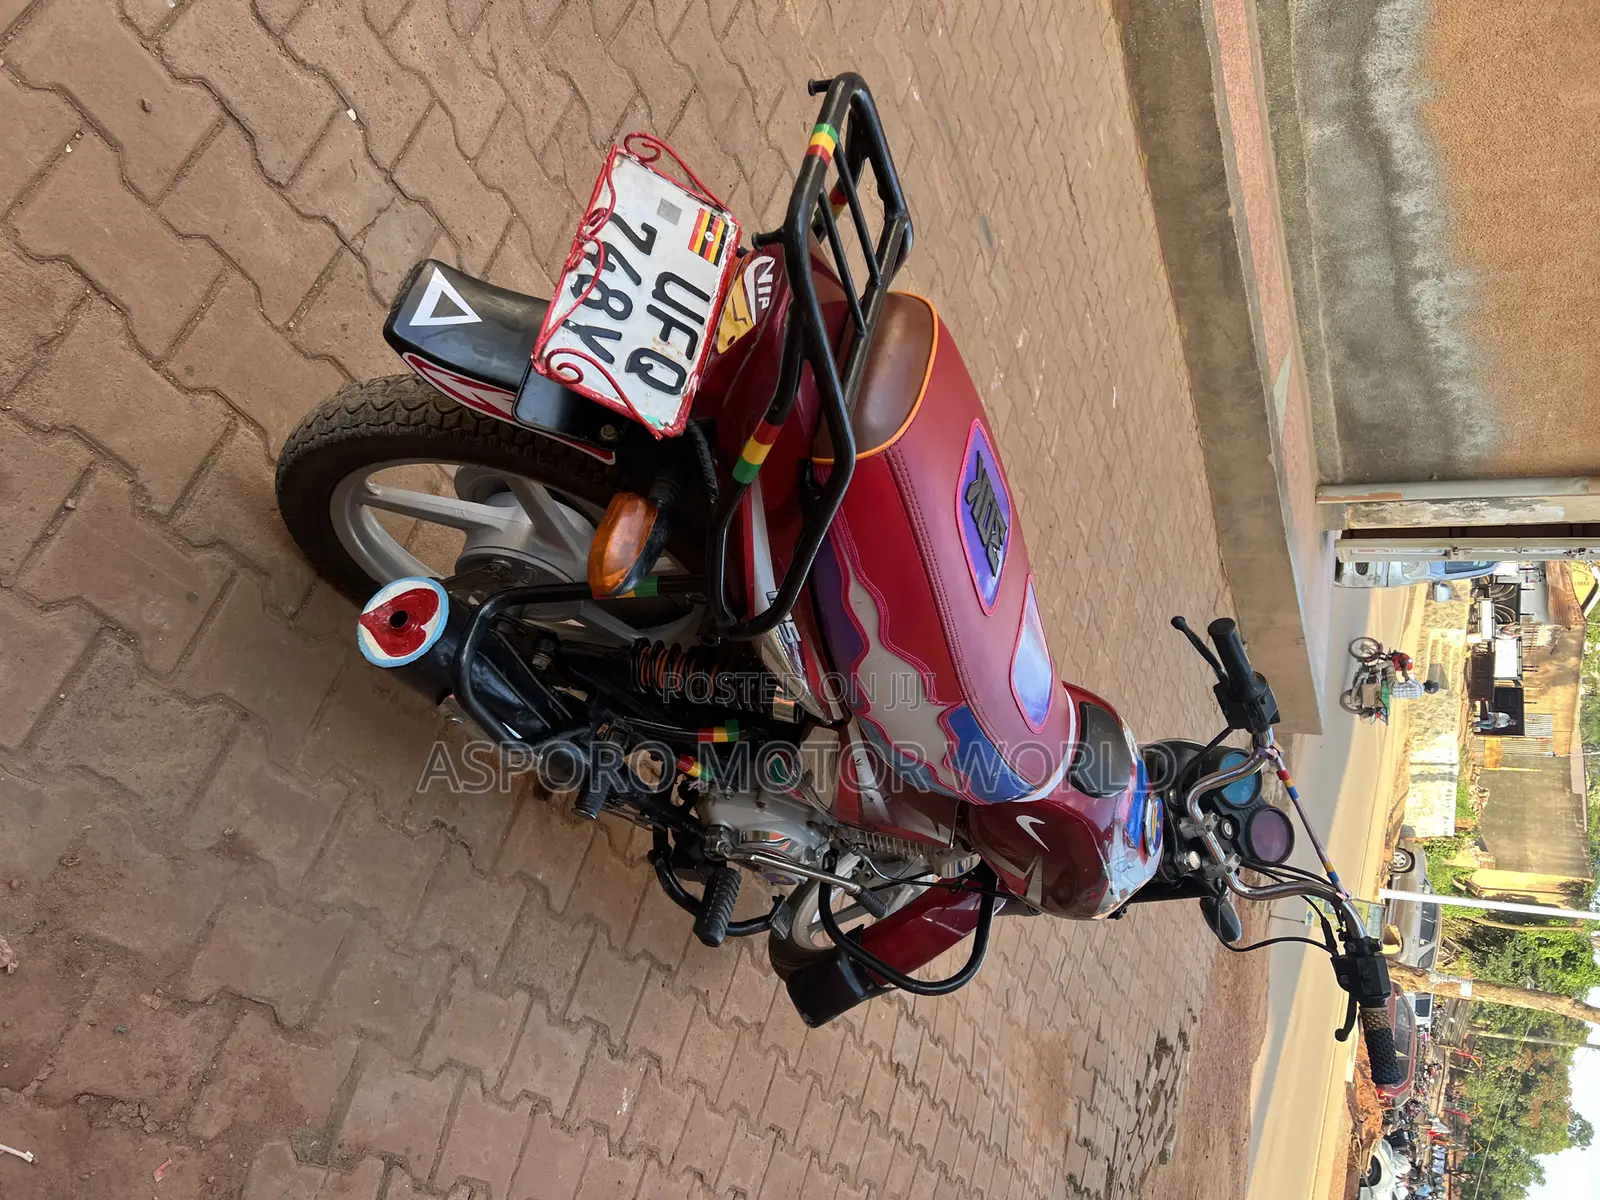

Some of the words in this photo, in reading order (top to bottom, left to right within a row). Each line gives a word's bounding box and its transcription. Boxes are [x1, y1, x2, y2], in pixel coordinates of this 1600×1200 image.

[560, 207, 658, 364] 748Y
[625, 271, 711, 395] UFQ
[755, 256, 777, 310] VIP
